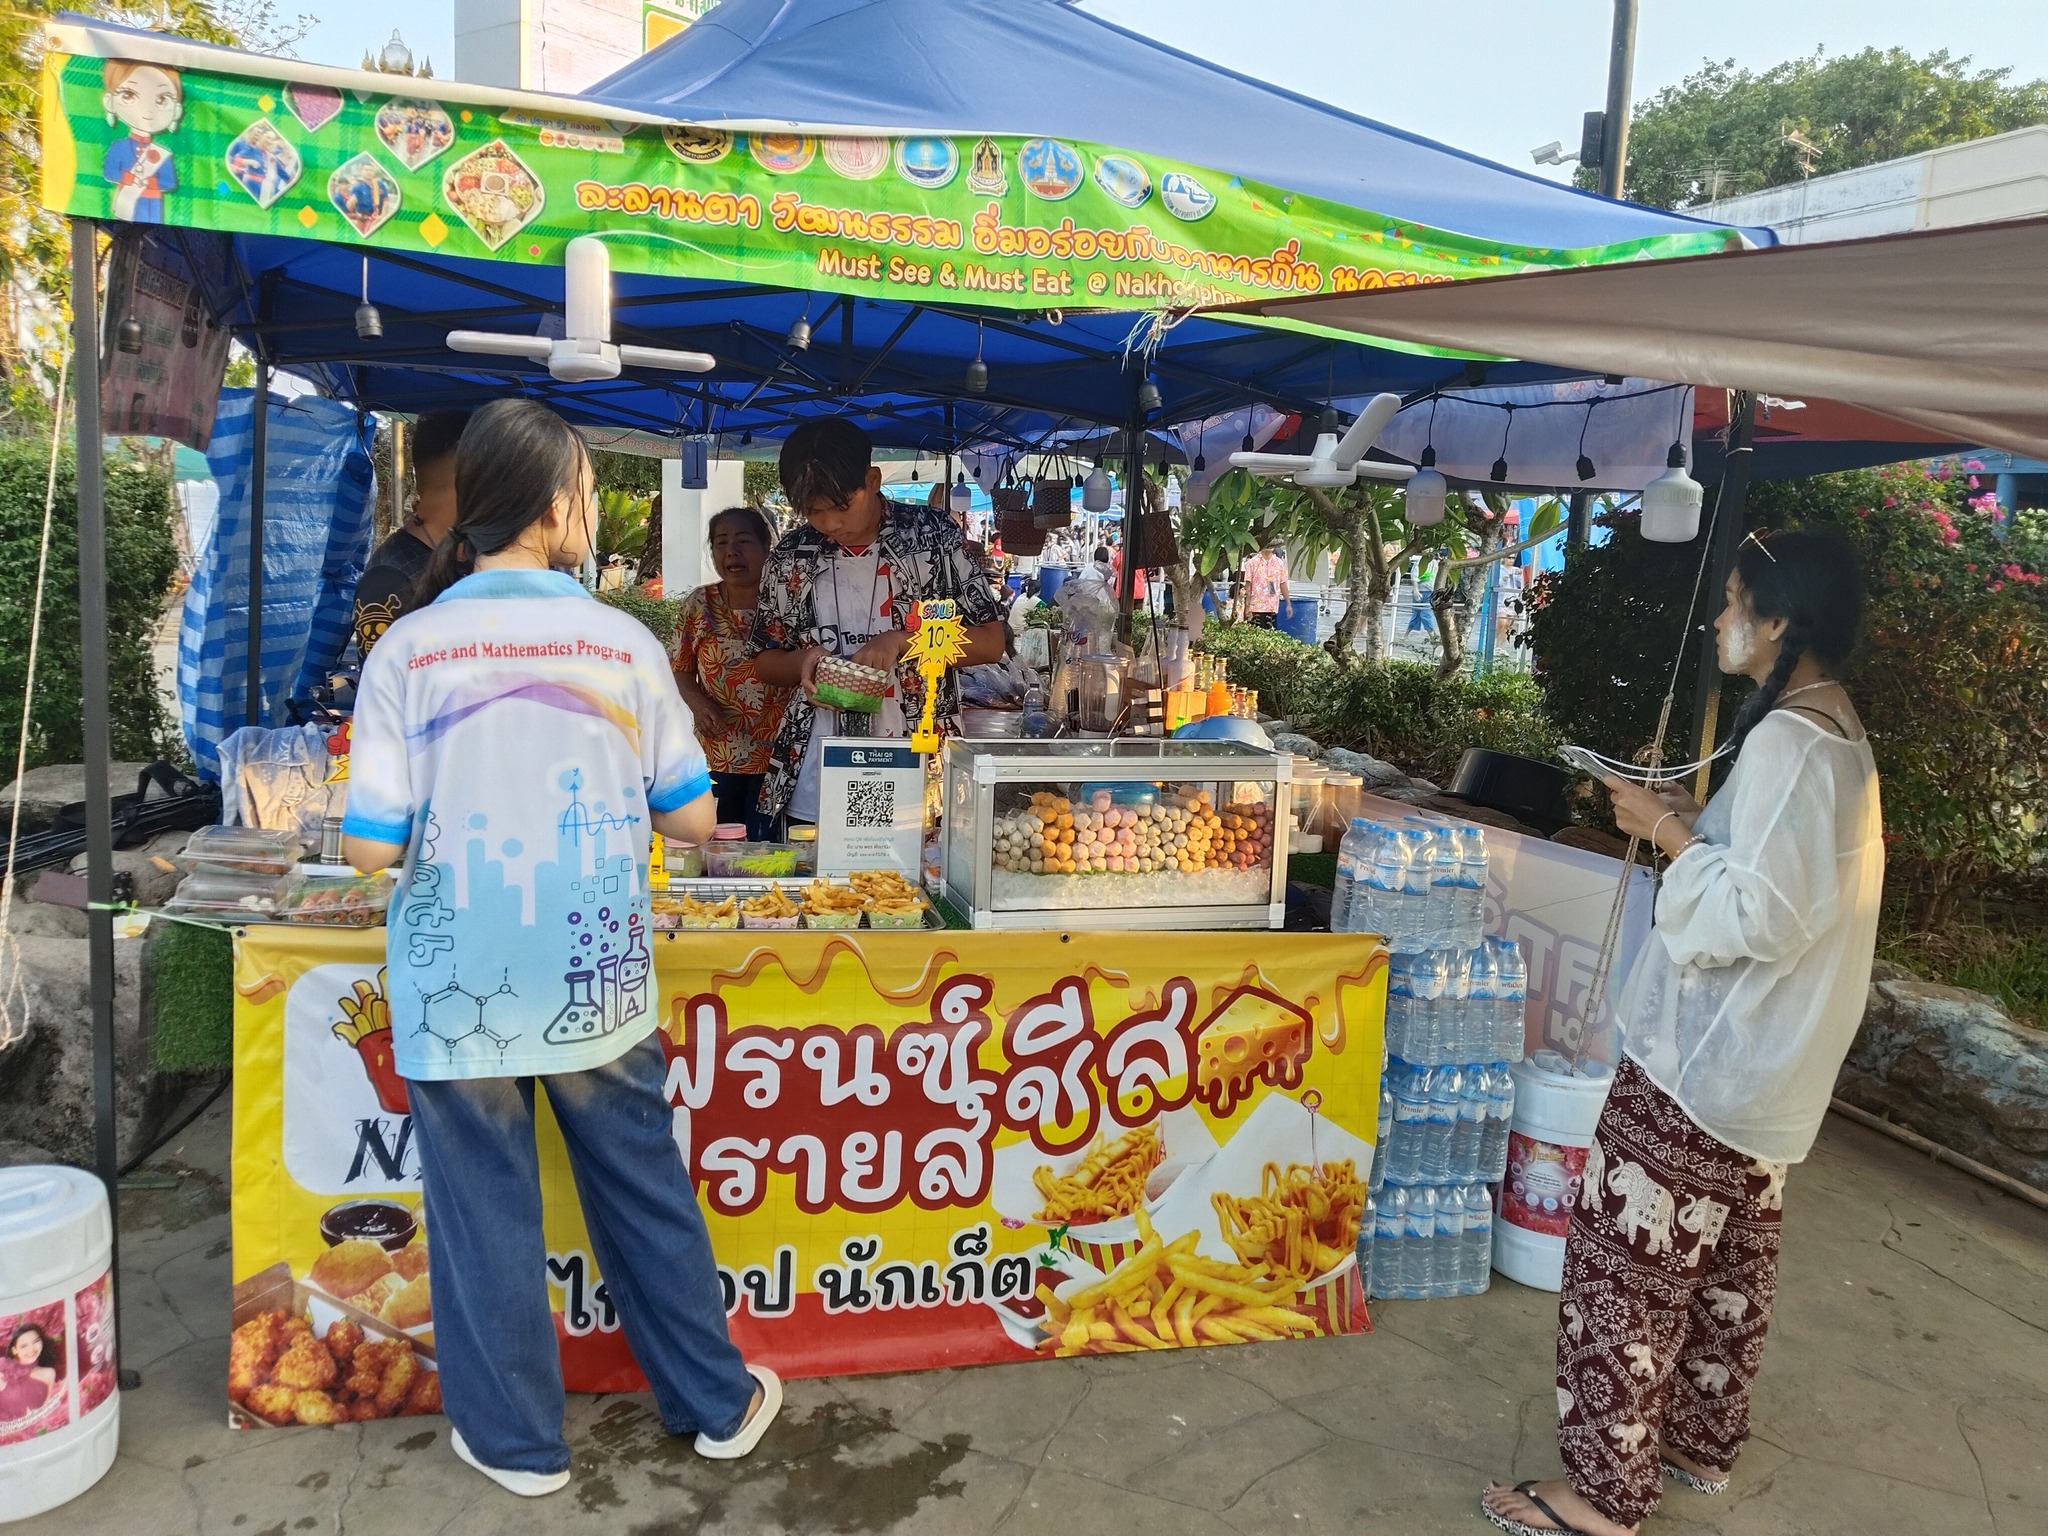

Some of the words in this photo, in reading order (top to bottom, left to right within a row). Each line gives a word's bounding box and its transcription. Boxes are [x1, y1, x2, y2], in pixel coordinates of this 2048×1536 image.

[576, 181, 760, 228] ละลานตา
[770, 192, 963, 249] วัฒนธรรม
[973, 202, 1322, 292] อิ่มอร่อยกับอาหารถิ่น
[817, 248, 881, 280] Must
[888, 260, 930, 286] See
[939, 262, 956, 288] &
[963, 263, 1025, 291] Must
[1031, 268, 1074, 295] Eat
[1087, 271, 1108, 294] @
[922, 600, 954, 620] SALE
[408, 649, 448, 670] cience
[451, 643, 478, 660] and
[481, 641, 573, 659] Mathematics
[577, 640, 632, 665] Program
[1005, 984, 1189, 1148] ชีส
[1400, 1104, 1424, 1113] Premier
[344, 1116, 422, 1185] N
[818, 1226, 1033, 1310] นักเก็ต
